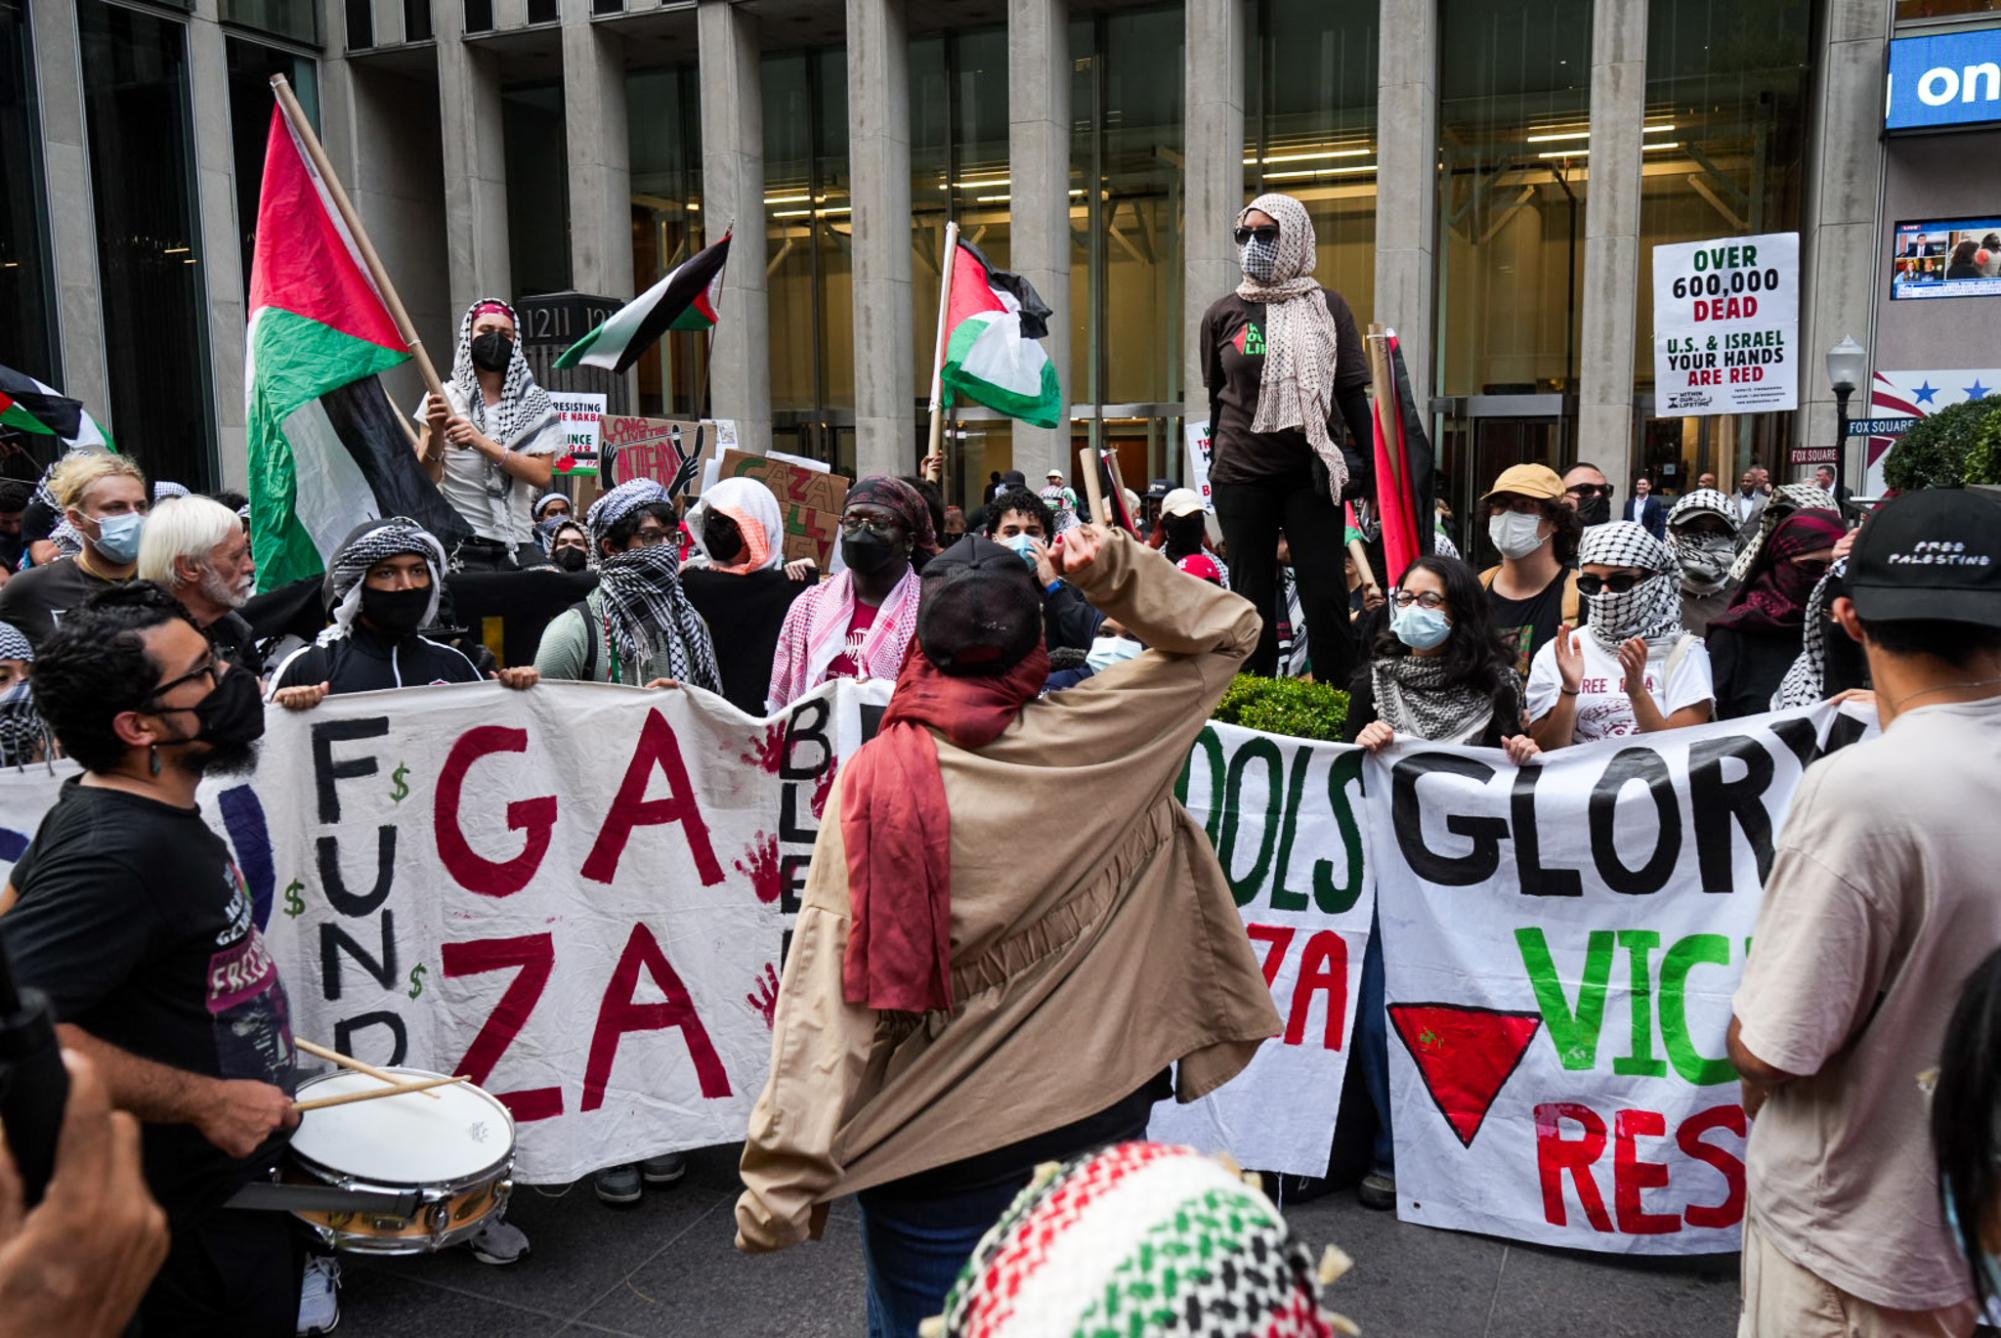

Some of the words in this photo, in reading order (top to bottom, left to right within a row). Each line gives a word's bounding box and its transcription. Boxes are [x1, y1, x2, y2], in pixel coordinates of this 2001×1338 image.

[1694, 245, 1757, 272] OVER
[1673, 268, 1779, 299] 600,000
[1694, 296, 1758, 322] DEAD
[526, 307, 571, 338] 1211
[1667, 337, 1699, 353] U.S.
[1706, 335, 1718, 351] &
[1725, 330, 1784, 349] ISRAEL
[1668, 352, 1717, 371] YOUR
[1724, 347, 1784, 367] HANDS
[1688, 369, 1722, 387] ARE
[1730, 366, 1764, 383] RED
[552, 402, 601, 412] RESISTING
[600, 418, 648, 442] LONG
[1849, 421, 1871, 433] FOX
[567, 434, 593, 445] INCE
[1792, 449, 1806, 462] FOX
[1807, 448, 1837, 461] SQUARE
[1913, 540, 1965, 553] FREE
[1887, 553, 1991, 566] PALESTINE
